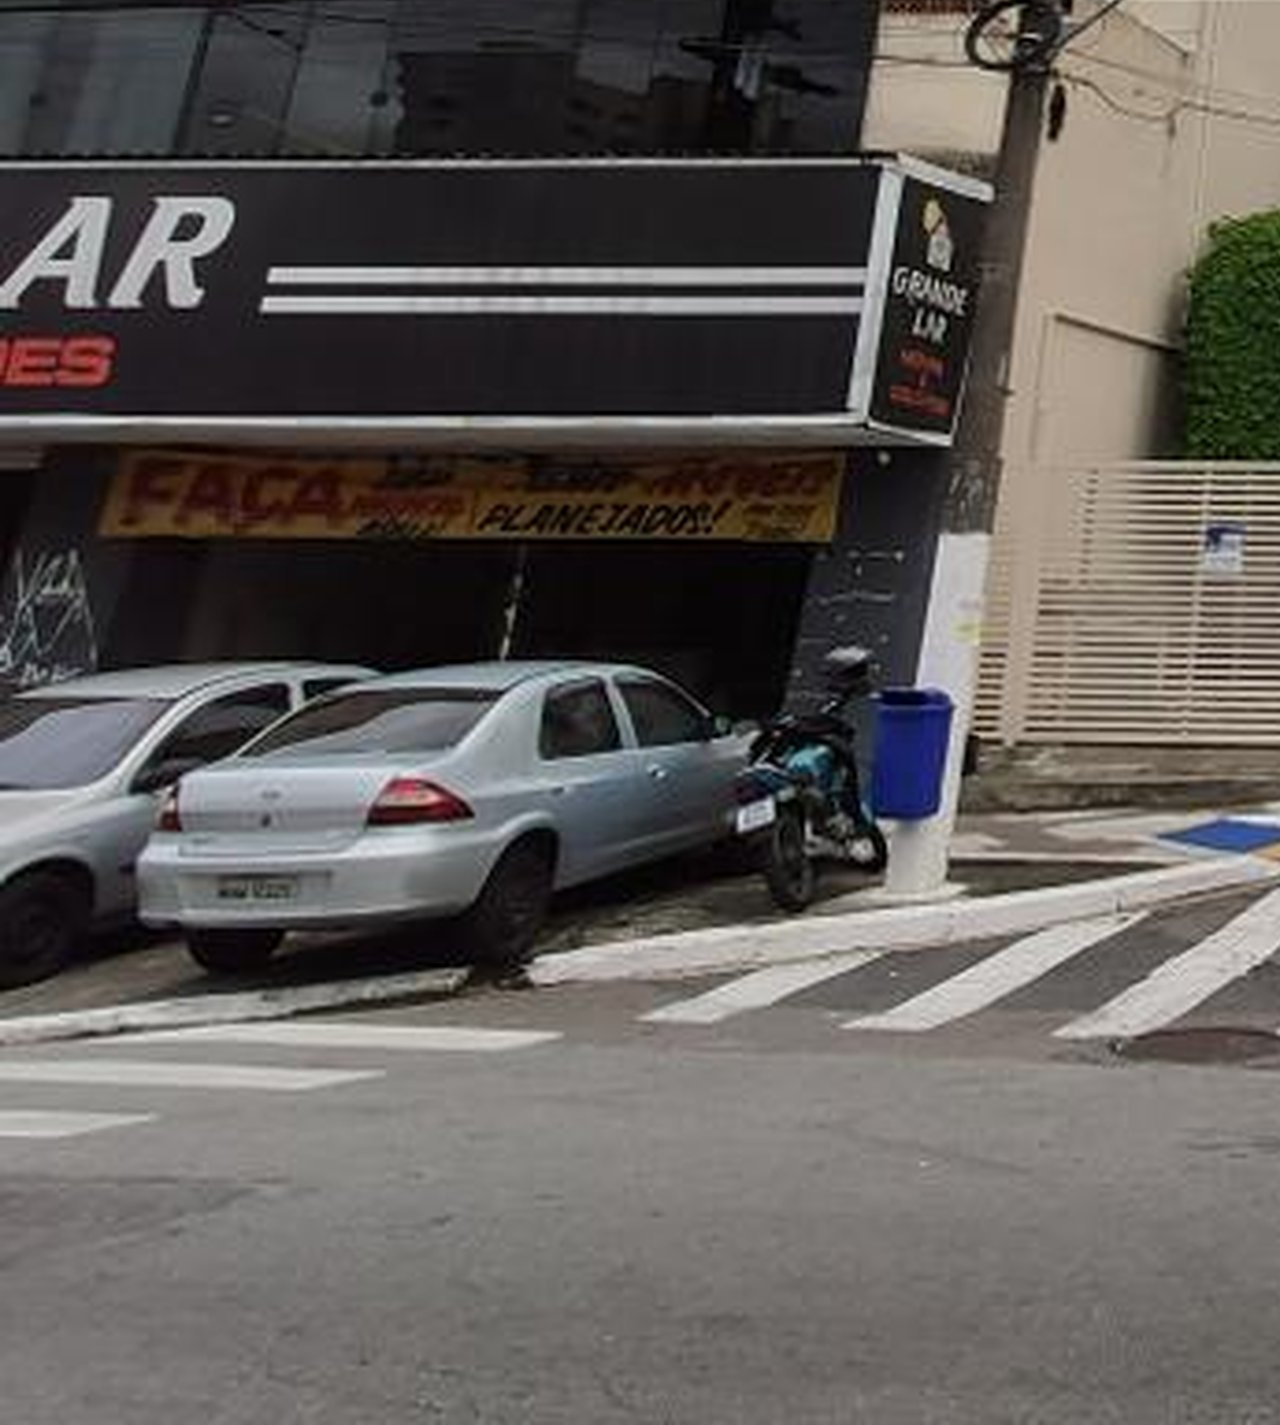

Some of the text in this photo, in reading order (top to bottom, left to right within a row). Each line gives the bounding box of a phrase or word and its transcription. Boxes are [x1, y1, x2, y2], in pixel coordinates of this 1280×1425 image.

[0, 196, 236, 308] AR
[893, 266, 969, 317] GRANDE
[911, 309, 949, 344] LAR
[0, 337, 116, 387] ES
[476, 499, 732, 534] PLANEJADOS!
